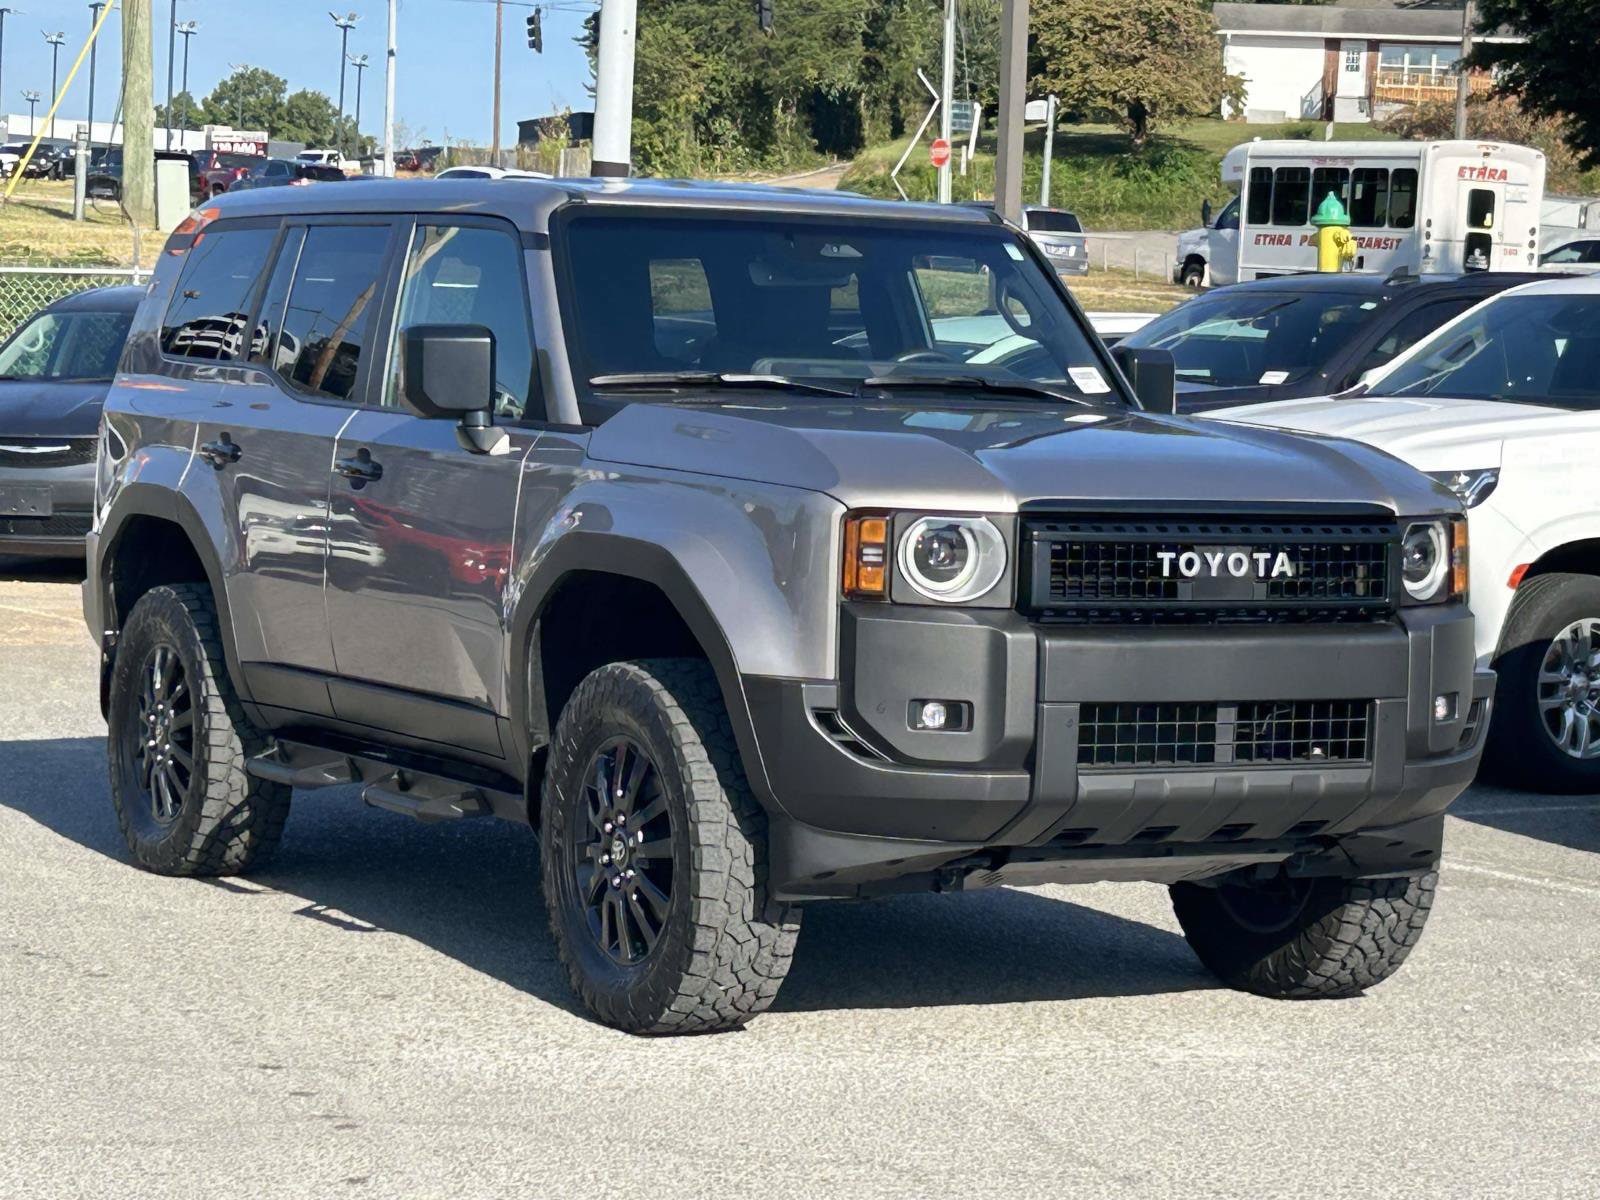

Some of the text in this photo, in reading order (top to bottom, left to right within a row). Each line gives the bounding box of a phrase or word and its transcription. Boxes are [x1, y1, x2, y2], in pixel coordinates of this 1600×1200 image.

[1457, 166, 1508, 181] ETHRA
[1254, 233, 1293, 246] ETHRA
[1156, 551, 1293, 577] TOYOTA
